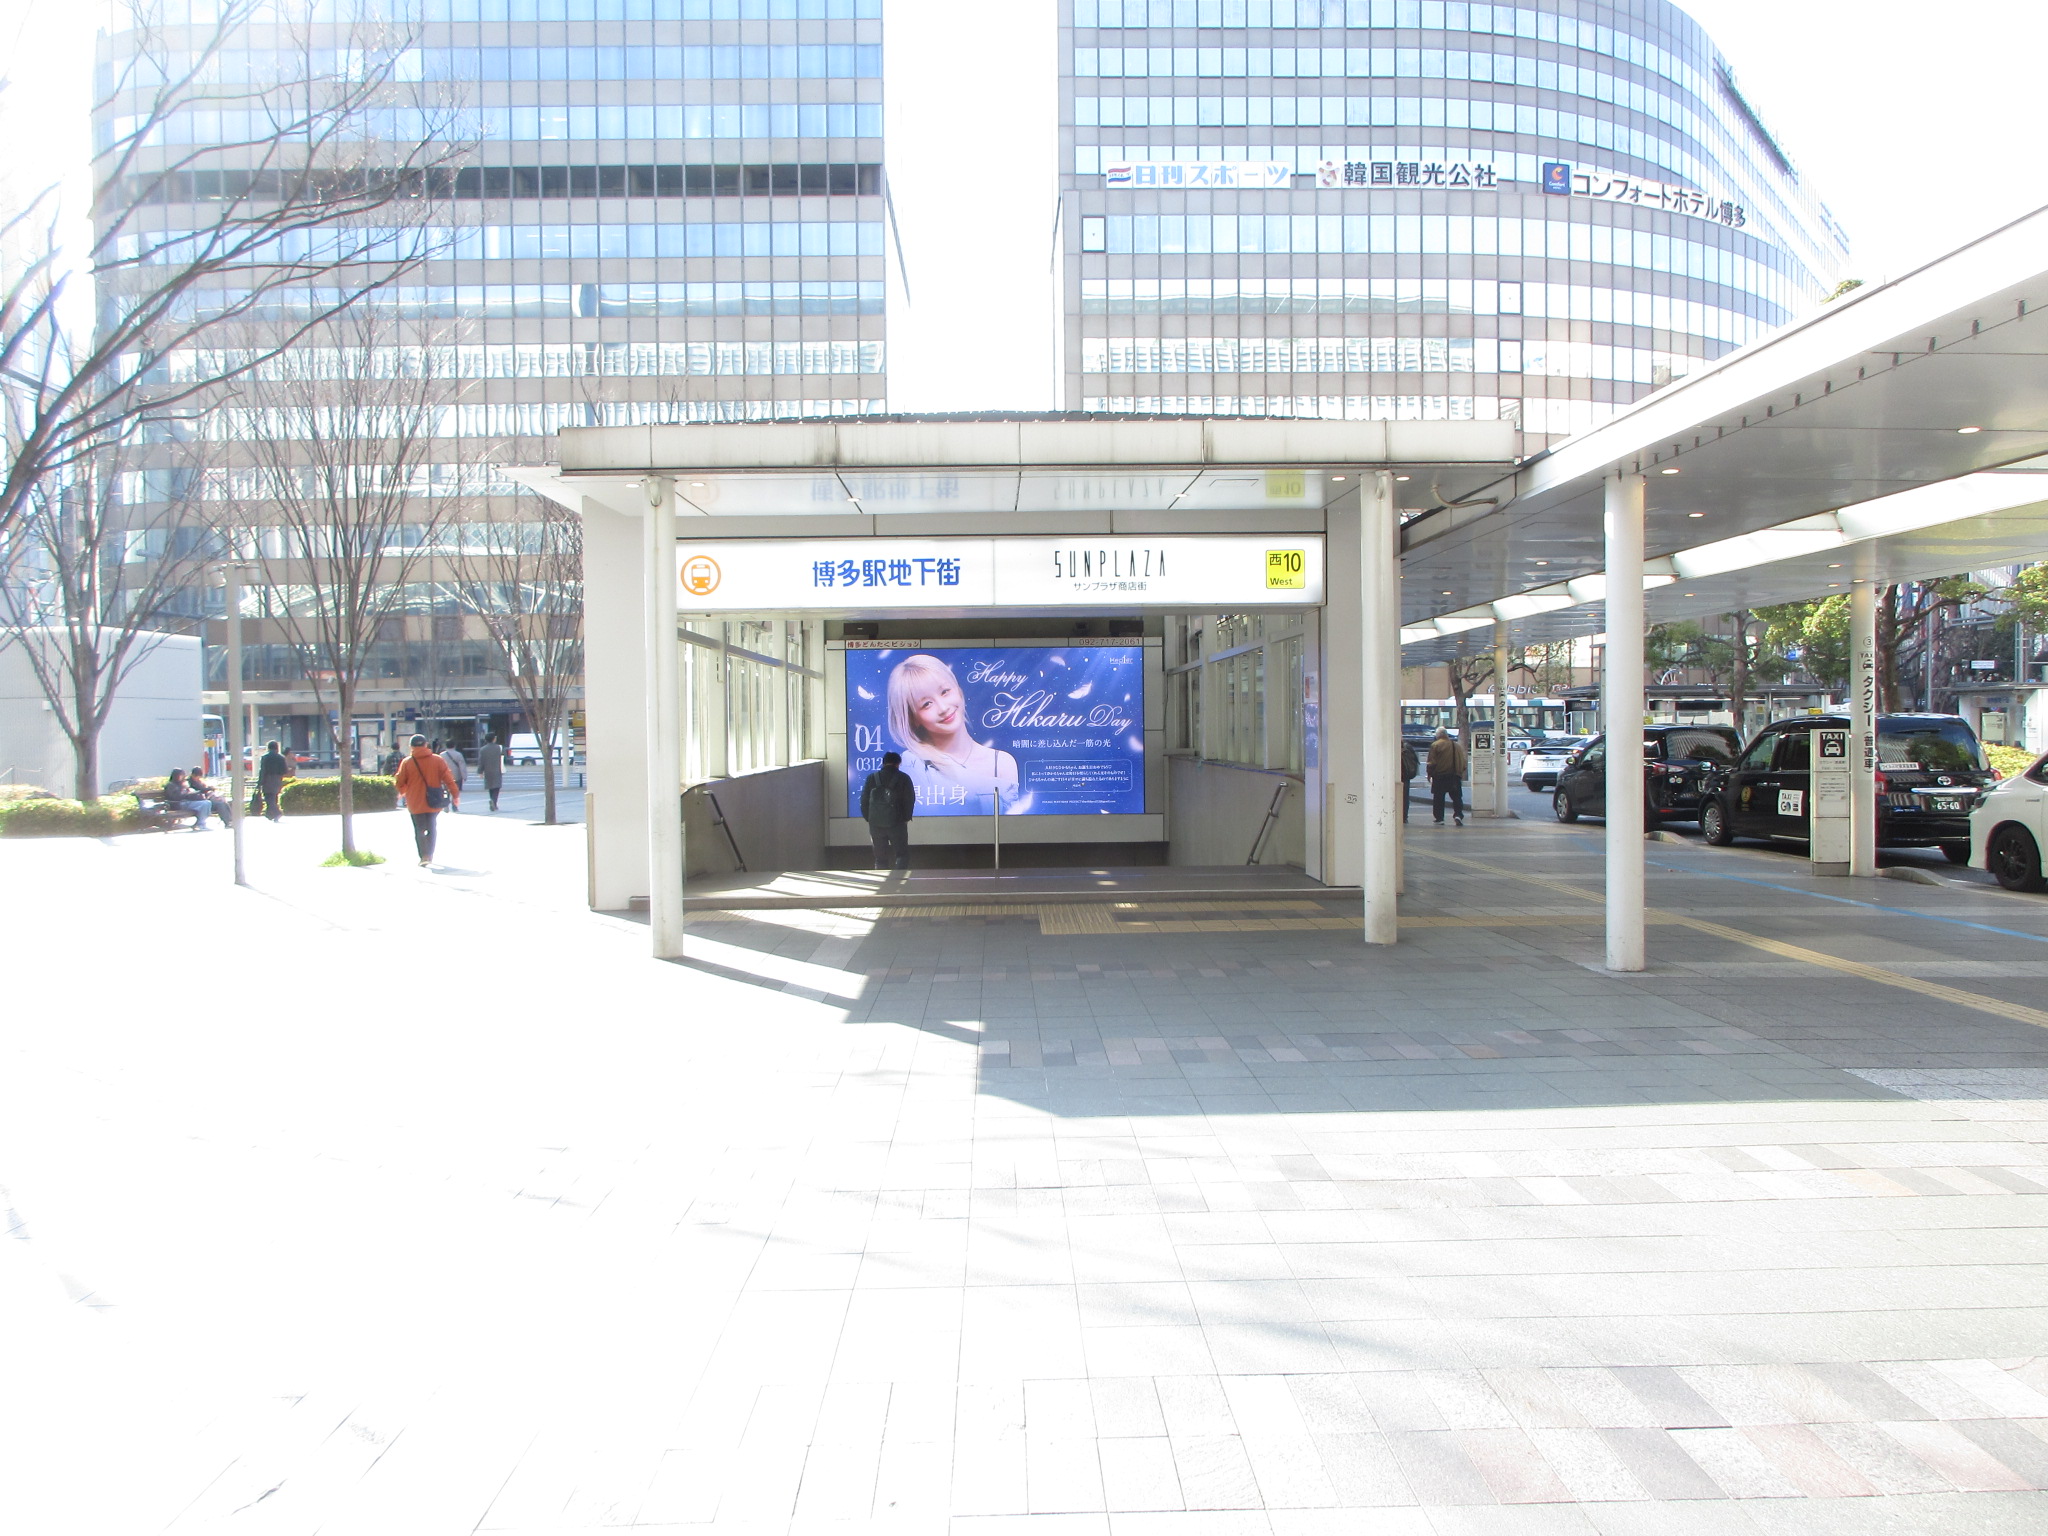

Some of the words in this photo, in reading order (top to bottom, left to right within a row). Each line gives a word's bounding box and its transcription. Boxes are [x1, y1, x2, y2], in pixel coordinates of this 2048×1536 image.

[1135, 164, 1289, 186] 日刊スポーツ
[1344, 162, 1497, 187] 韓国観光公社
[1573, 174, 1746, 228] コンフォートホテル博多
[813, 559, 961, 587] 博多駅地下街
[1055, 550, 1166, 577] SUNPLAZA
[1269, 554, 1282, 566] 西
[1284, 553, 1302, 572] 10
[1073, 582, 1147, 591] サンプラザ商店街
[1269, 578, 1294, 586] West
[1079, 638, 1140, 646] 092-717-2061
[967, 660, 1028, 691] Happy
[982, 690, 1086, 729] Hikaru
[1087, 704, 1132, 736] Day
[855, 725, 884, 752] 04
[856, 757, 883, 772] 0312
[1937, 801, 1959, 810] 65-60
